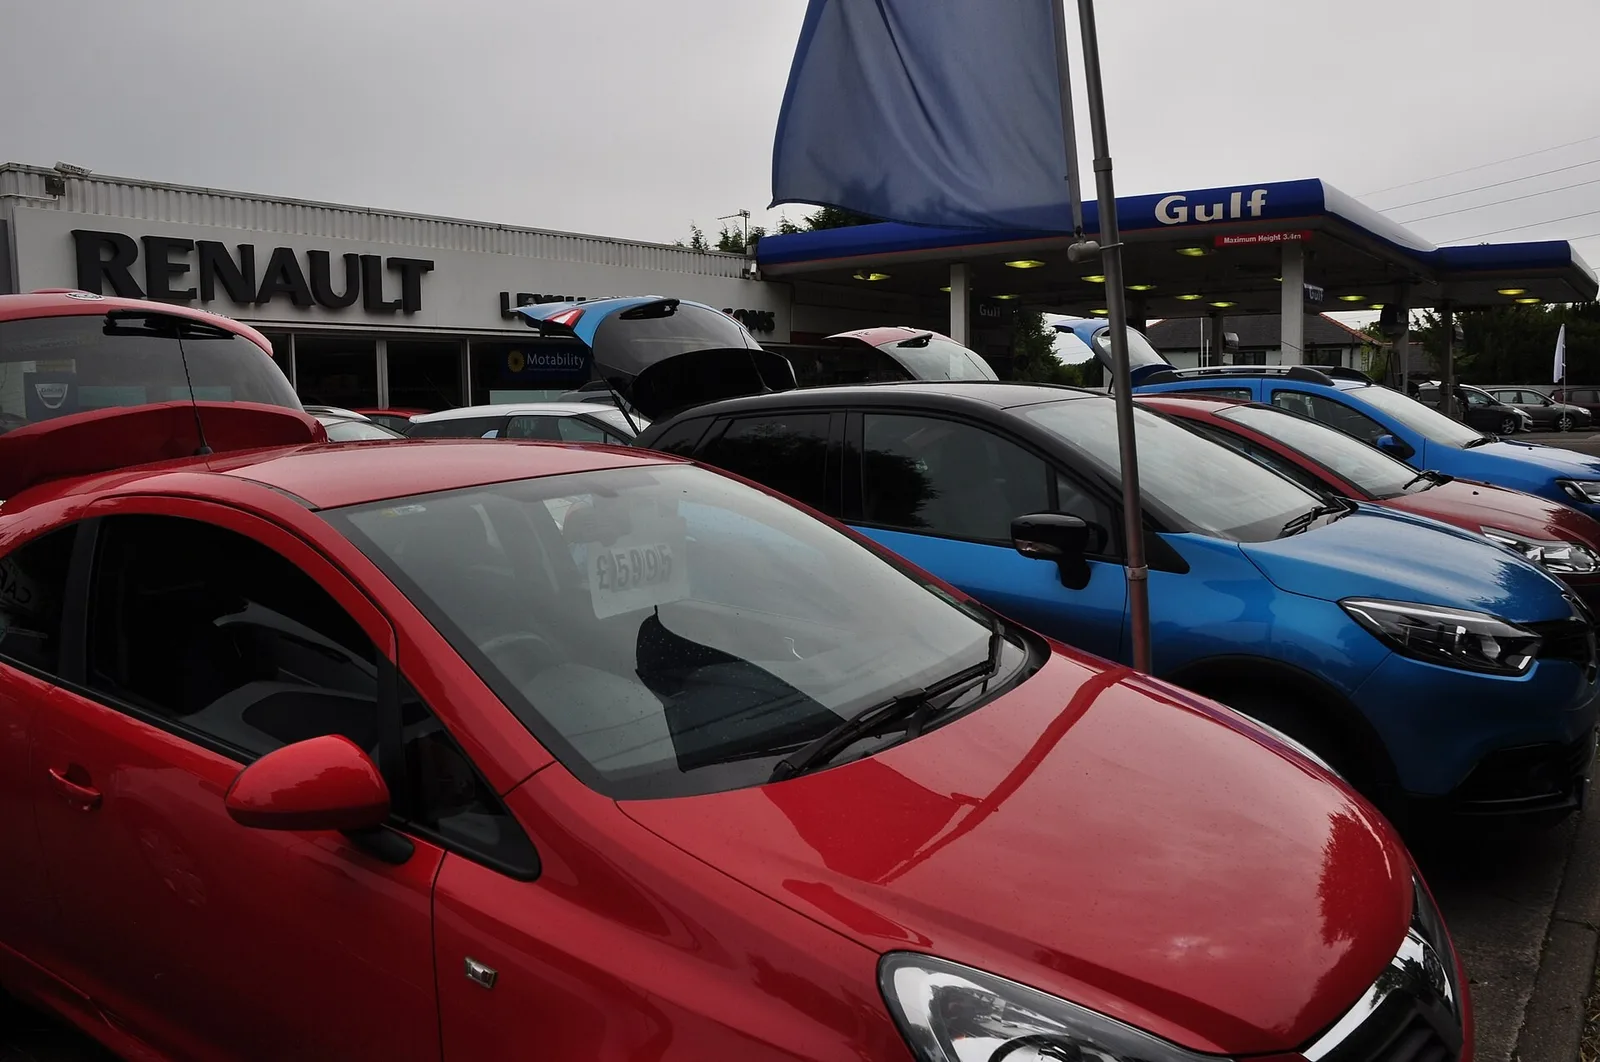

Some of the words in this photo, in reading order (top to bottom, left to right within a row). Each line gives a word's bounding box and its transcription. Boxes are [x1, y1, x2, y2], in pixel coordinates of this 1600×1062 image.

[1155, 190, 1268, 225] Gulf
[1223, 236, 1257, 244] Maximum
[1258, 234, 1281, 243] Height
[71, 229, 434, 313] RENAULT
[526, 352, 585, 369] Motability
[596, 544, 673, 590] £5995
